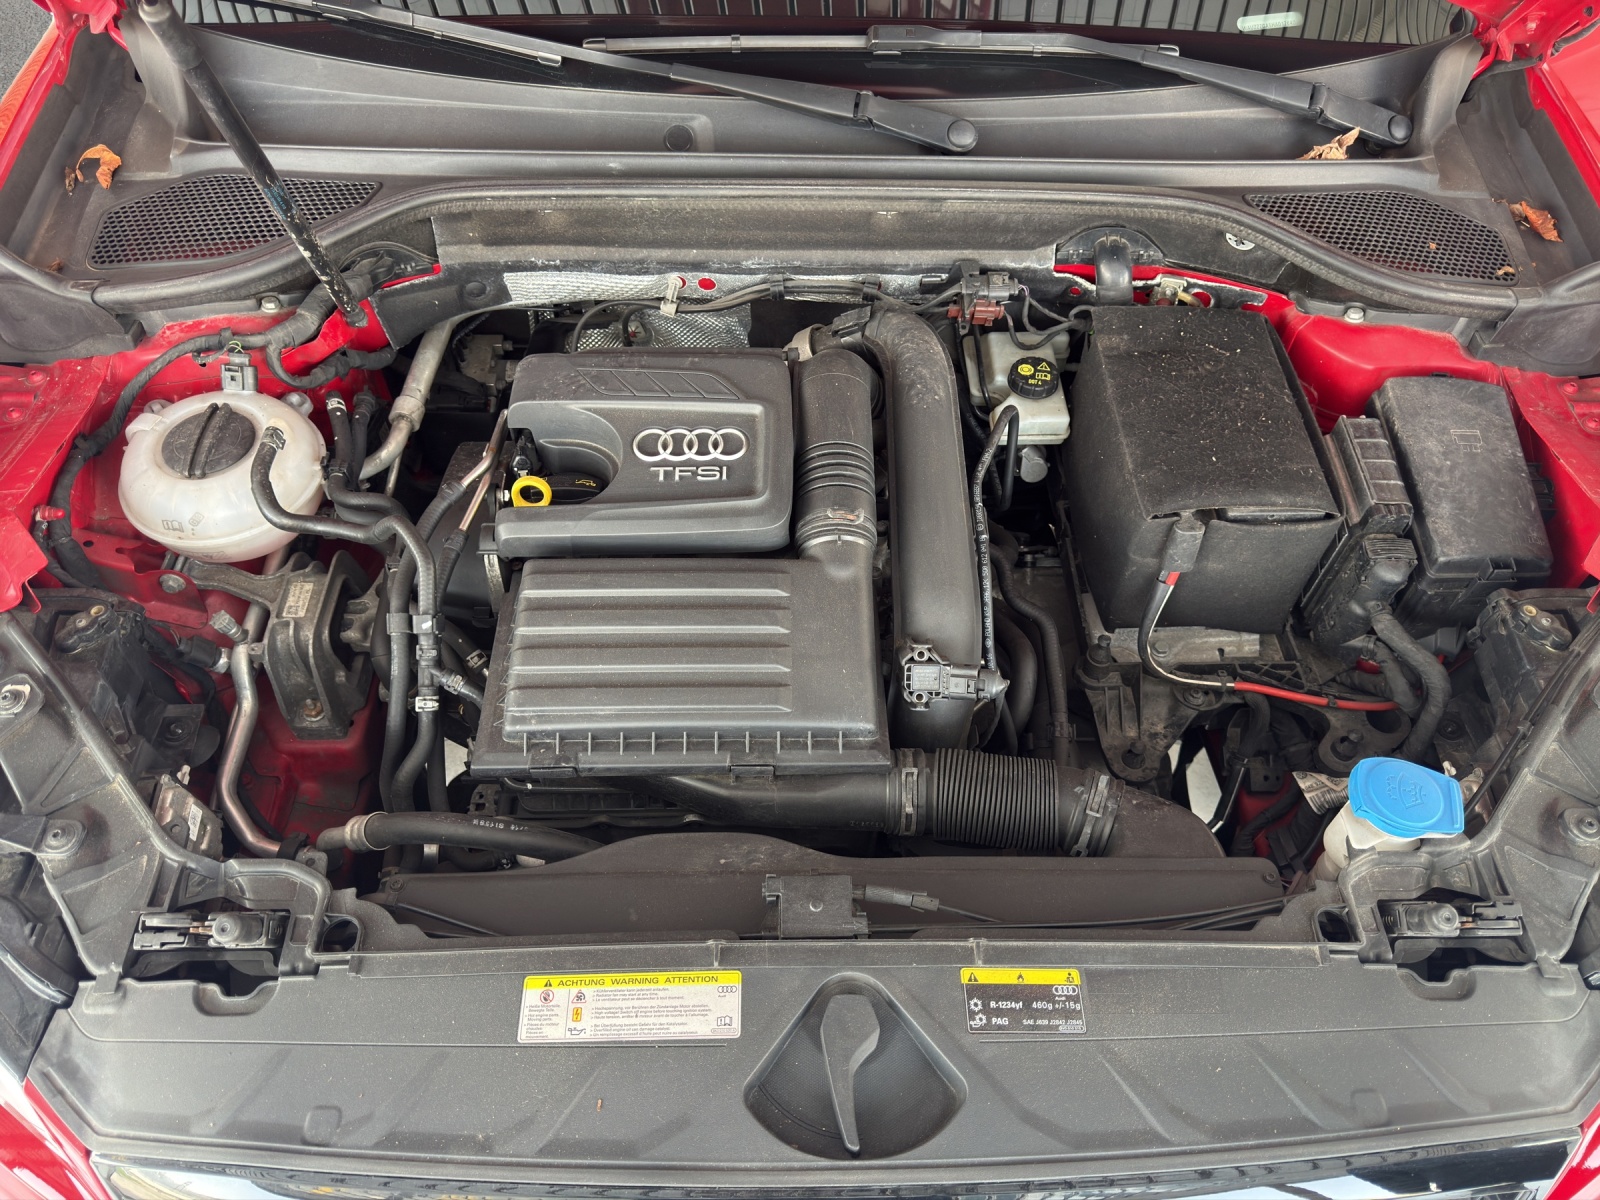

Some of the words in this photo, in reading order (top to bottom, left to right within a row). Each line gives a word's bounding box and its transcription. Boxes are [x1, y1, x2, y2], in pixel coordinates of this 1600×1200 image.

[649, 465, 729, 482] TFSI
[557, 978, 605, 987] ACHTUNG
[611, 977, 659, 985] WARNING
[664, 975, 718, 983] ATTENTION
[990, 1001, 1023, 1009] R-1234yf
[1032, 1001, 1052, 1010] 460g
[992, 1017, 1009, 1025] PAG
